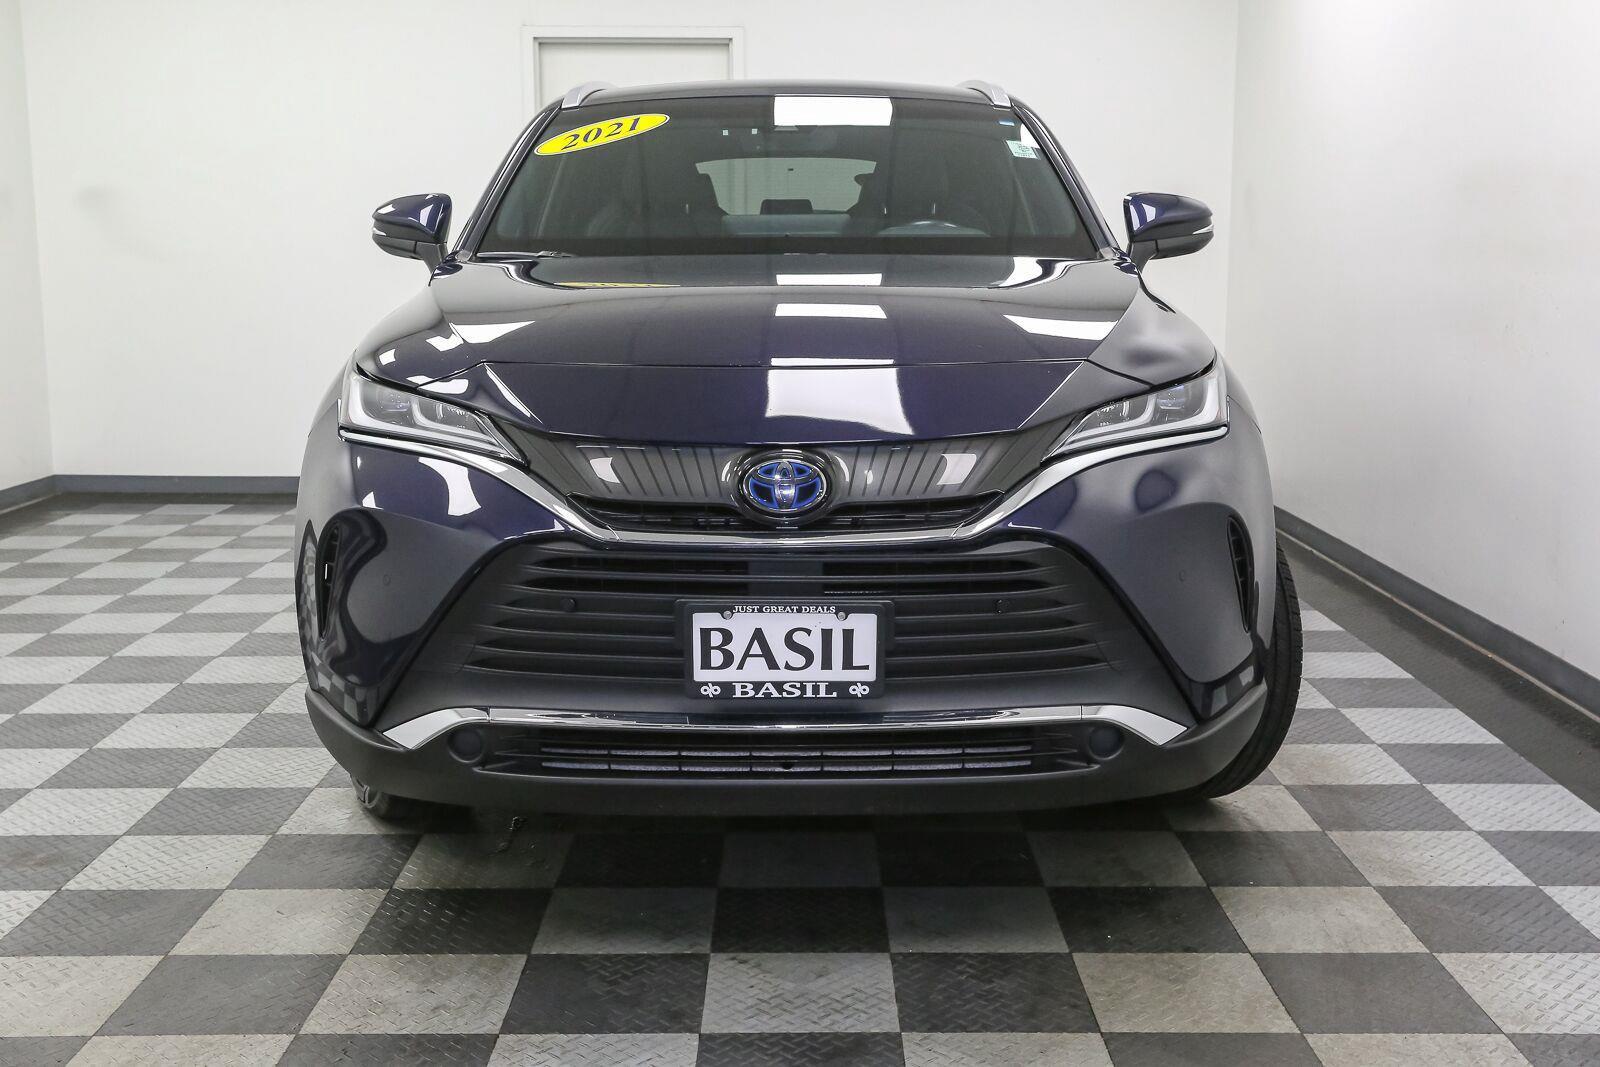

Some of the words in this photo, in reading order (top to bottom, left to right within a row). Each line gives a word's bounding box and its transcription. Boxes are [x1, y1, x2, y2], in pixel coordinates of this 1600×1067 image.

[561, 117, 640, 150] 2021
[732, 605, 760, 613] JUST
[763, 605, 799, 614] GREAT
[802, 605, 836, 614] DEALS
[699, 627, 870, 672] BASIL
[732, 682, 838, 698] BASIL
